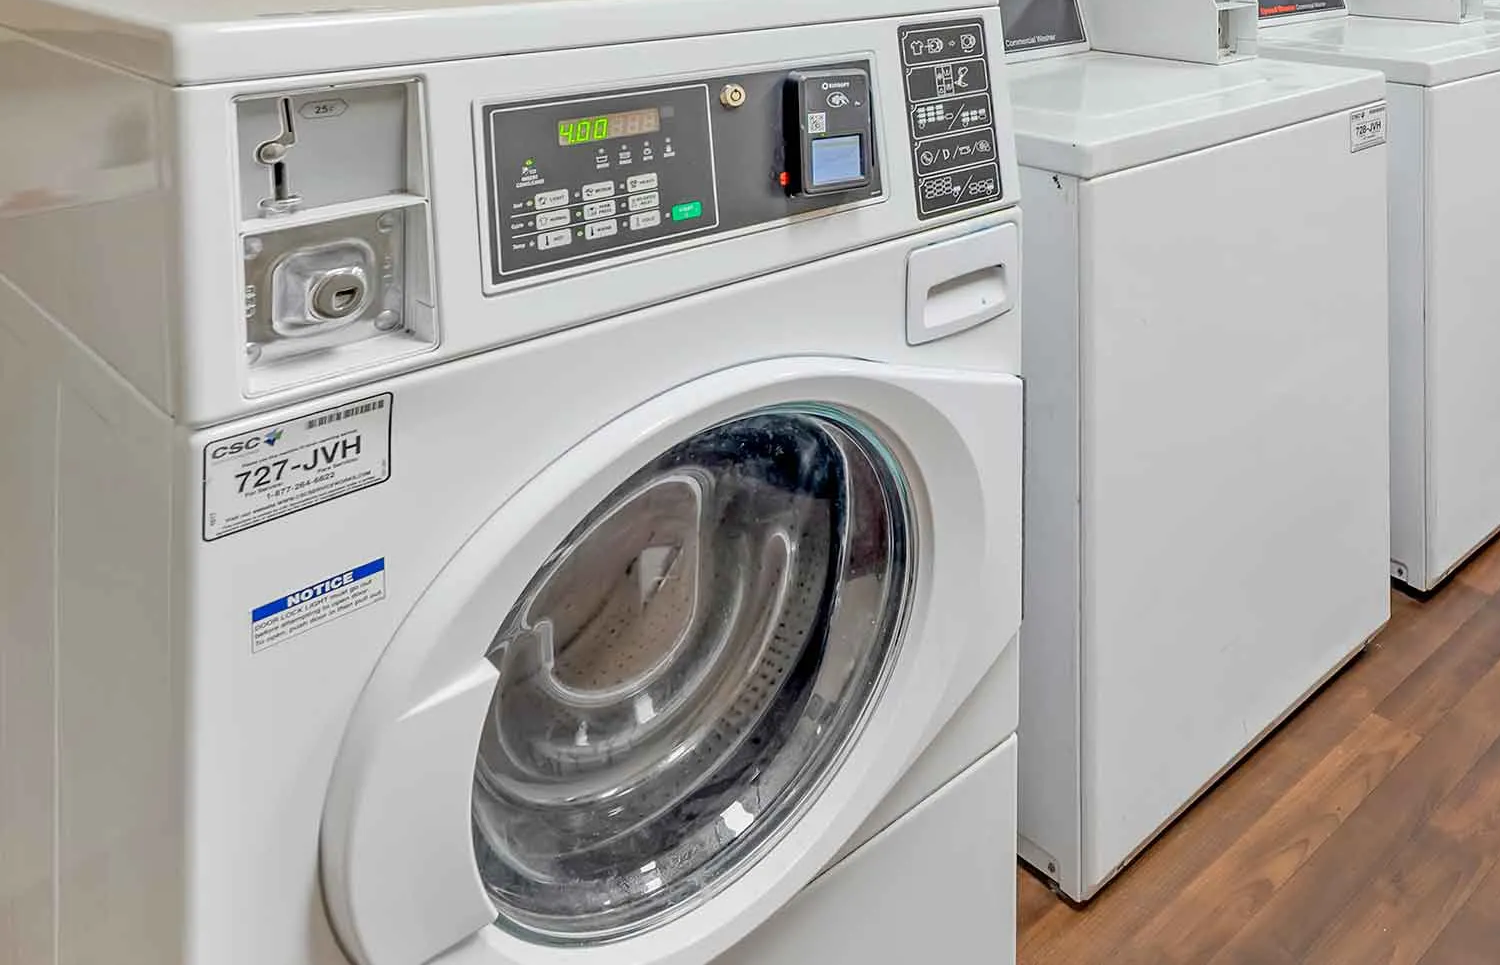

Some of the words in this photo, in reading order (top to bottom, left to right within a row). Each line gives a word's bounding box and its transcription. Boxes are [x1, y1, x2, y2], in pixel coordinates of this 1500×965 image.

[560, 118, 608, 145] 4.00
[212, 437, 261, 459] CSC
[235, 435, 361, 493] 727-JVH
[287, 571, 354, 608] NOTICE
